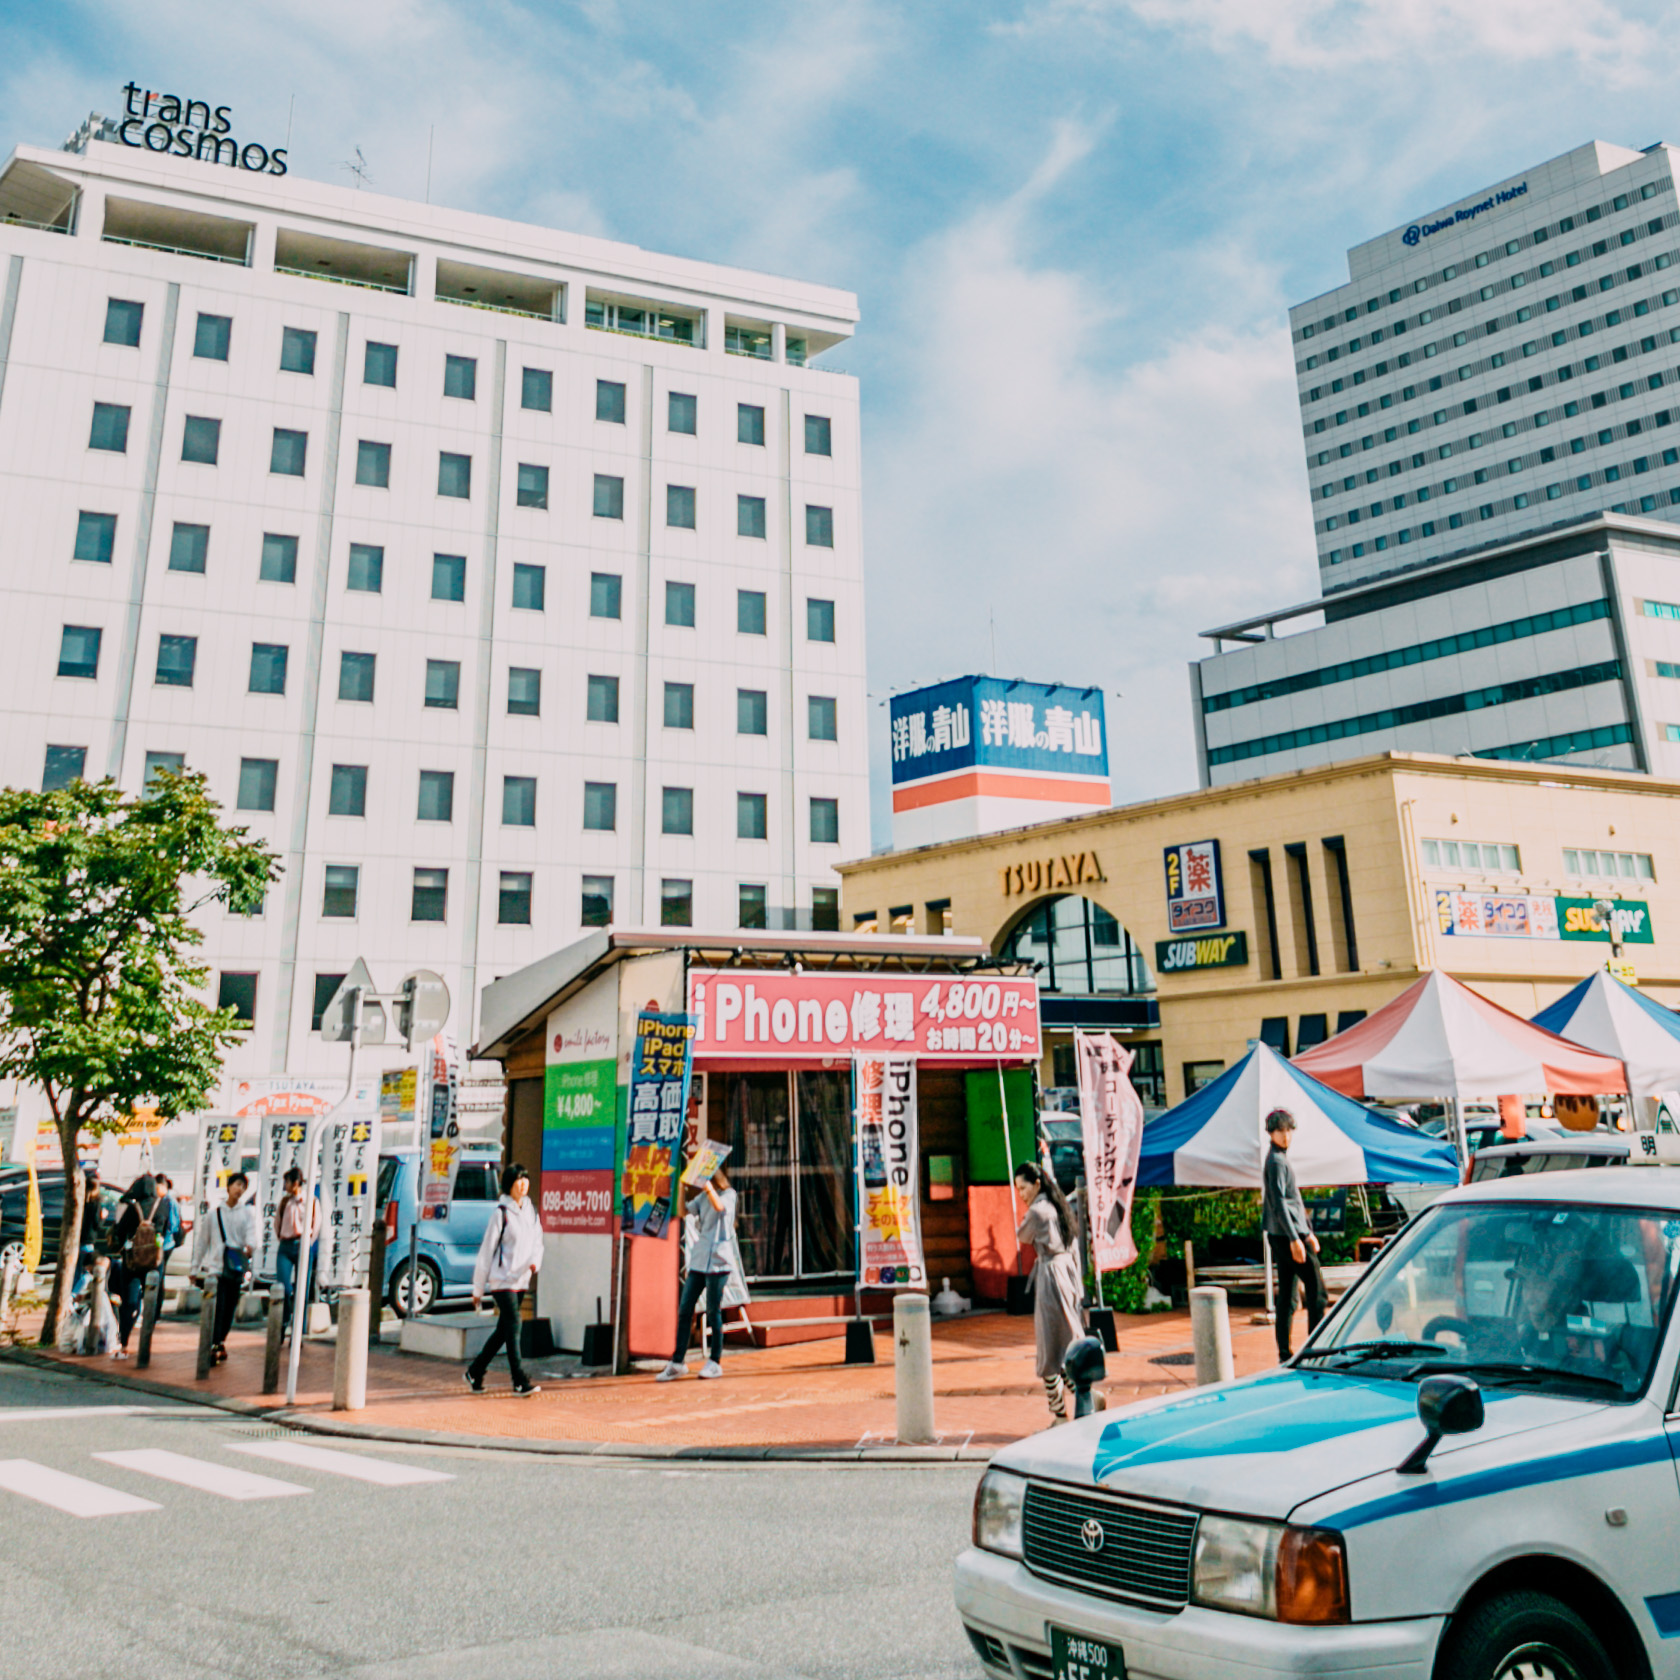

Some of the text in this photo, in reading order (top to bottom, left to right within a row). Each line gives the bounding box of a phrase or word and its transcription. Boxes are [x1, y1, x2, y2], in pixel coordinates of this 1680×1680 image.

[122, 80, 232, 135] trans
[119, 119, 288, 177] cosmos
[1421, 180, 1528, 238] Daiwa Roynet Hotel
[892, 702, 970, 763] 洋服の青山
[980, 698, 1103, 757] 洋服の青山
[1166, 852, 1181, 897] 2F
[1186, 847, 1212, 894] 薬
[1456, 895, 1480, 931] 薬
[1564, 907, 1646, 934] SUBAY
[1163, 934, 1236, 969] SUBWAY
[637, 1018, 696, 1040] iPhone
[643, 1038, 686, 1058] iPad
[639, 1057, 686, 1077] スマホ
[270, 1081, 316, 1091] TSUTAYA
[633, 1081, 683, 1112] 高価
[860, 1059, 885, 1123] 修理
[630, 1111, 681, 1143] 買取
[887, 1060, 912, 1187] iPhone
[542, 1189, 612, 1212] 098-894-7010
